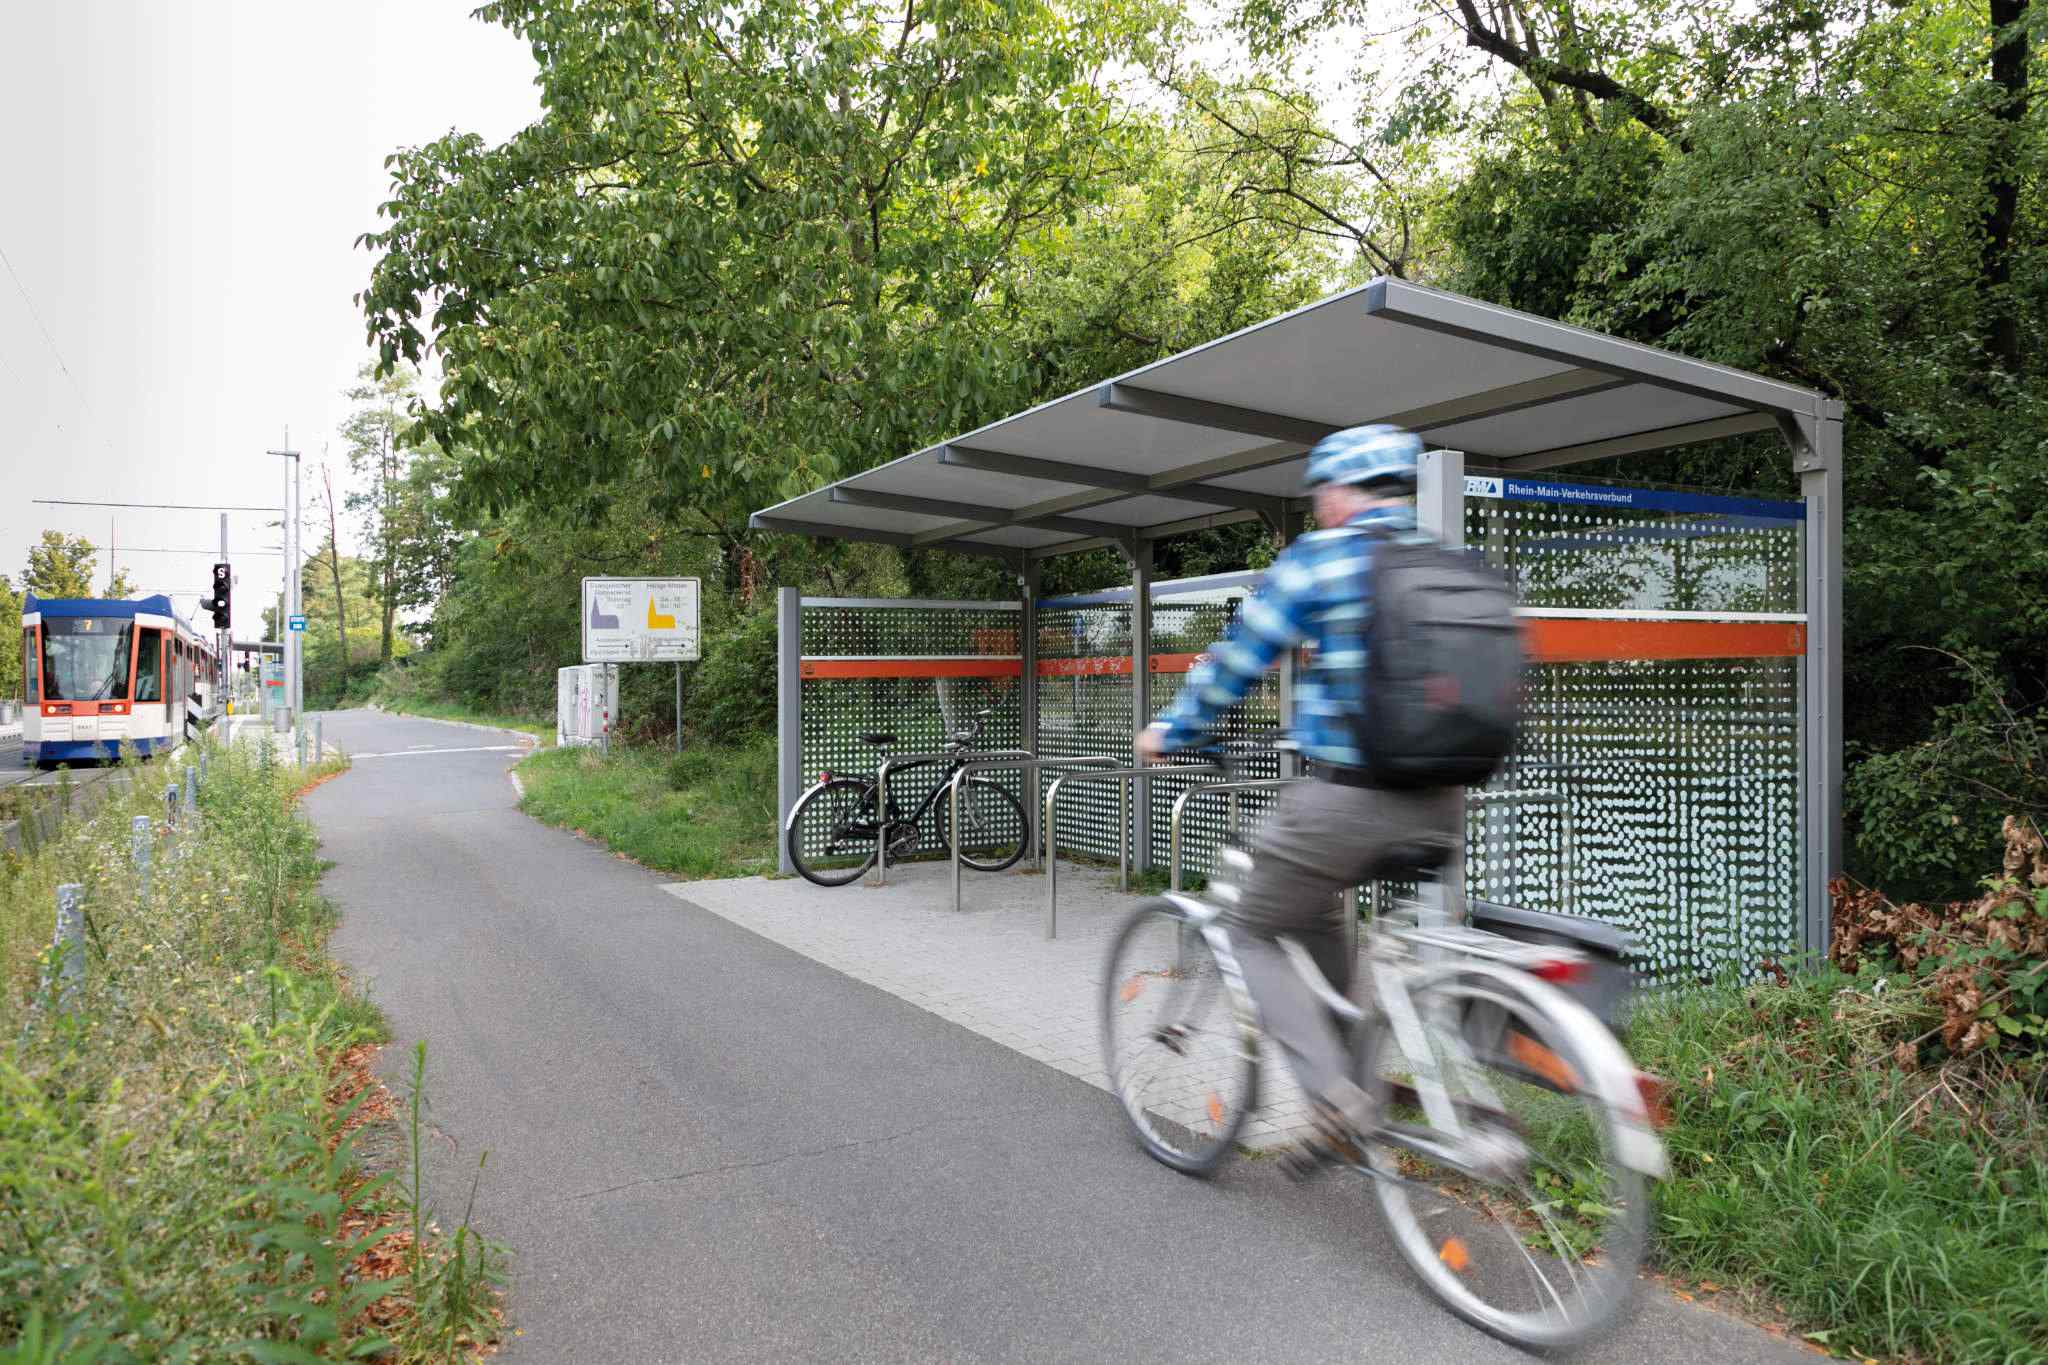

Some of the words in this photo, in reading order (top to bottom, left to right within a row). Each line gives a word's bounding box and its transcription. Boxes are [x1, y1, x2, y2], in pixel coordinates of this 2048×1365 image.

[1508, 483, 1633, 504] Rhein-Main-Verkehrsverbund
[217, 567, 226, 579] S
[83, 619, 93, 631] 7
